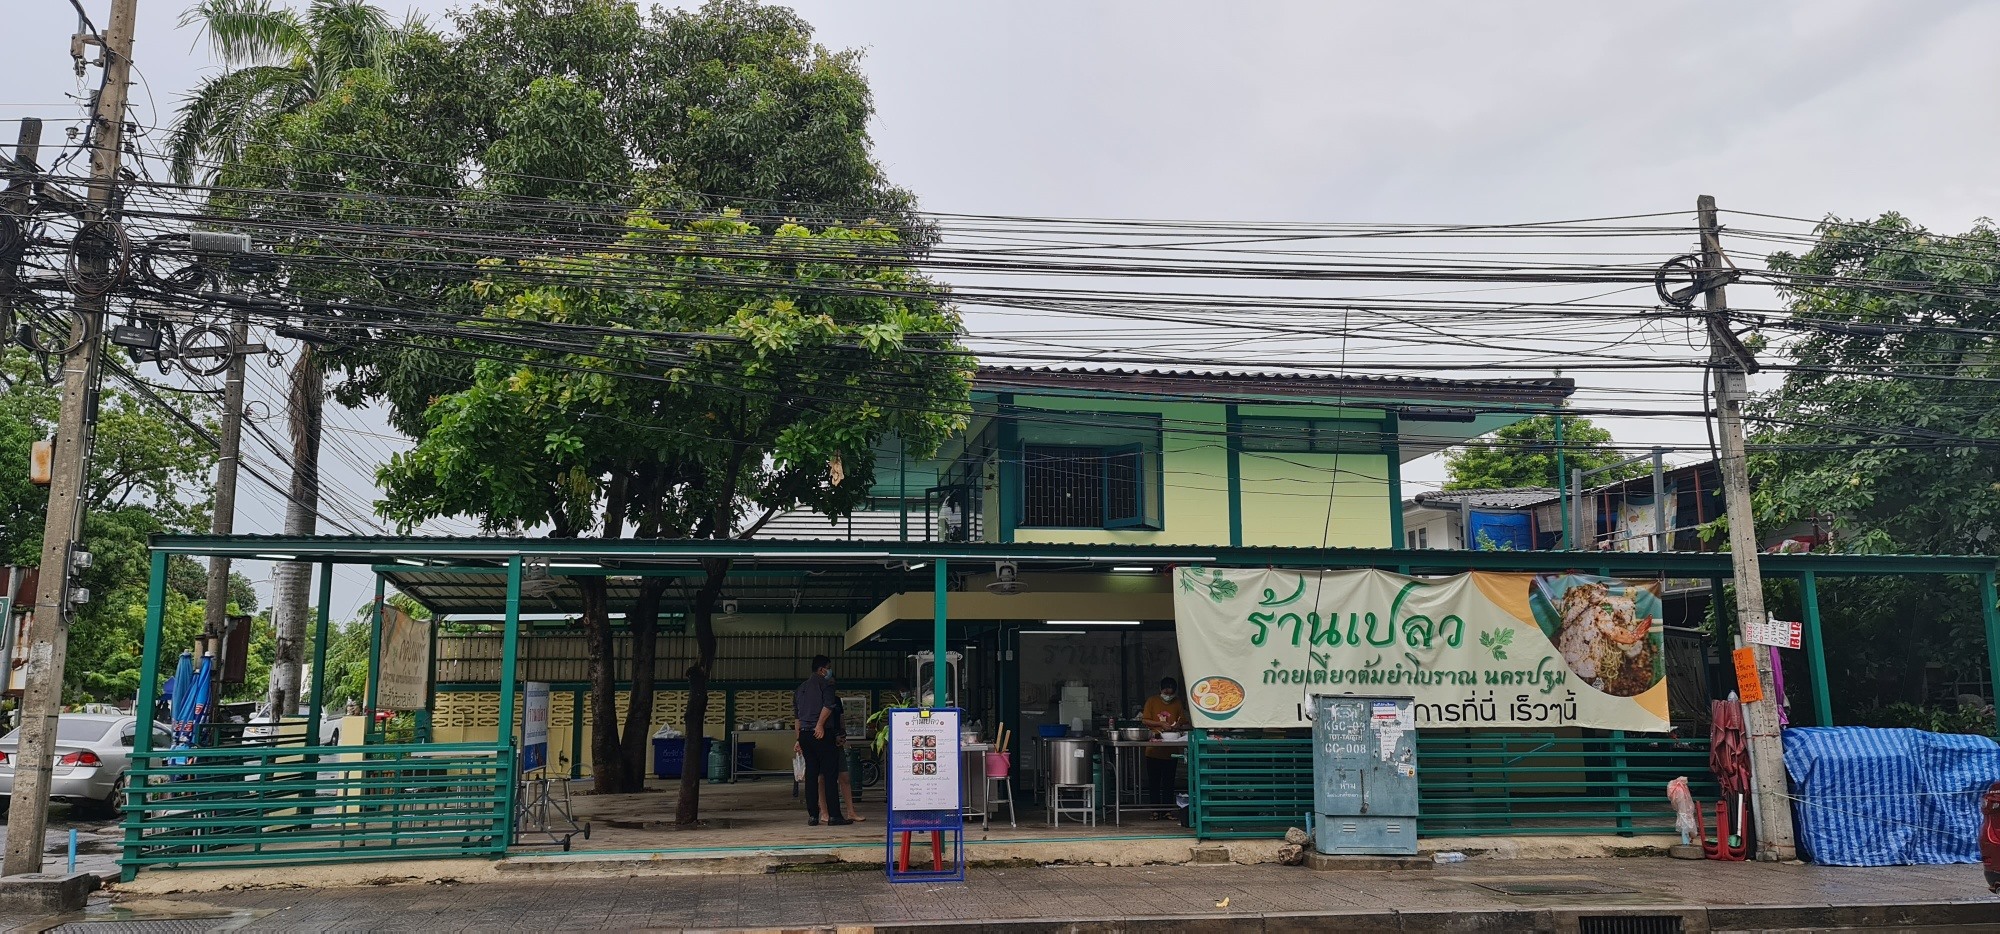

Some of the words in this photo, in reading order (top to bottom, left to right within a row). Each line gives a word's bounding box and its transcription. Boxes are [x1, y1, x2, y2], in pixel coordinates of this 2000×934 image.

[1247, 572, 1466, 649] ร้านเปลว
[1262, 651, 1477, 686] ก๋วยเตี๋ยวต้มยำโบราณ
[1484, 656, 1567, 694] นครปฐม
[1510, 689, 1577, 724] เร็วๆนี้
[1325, 743, 1366, 754] CC-008
